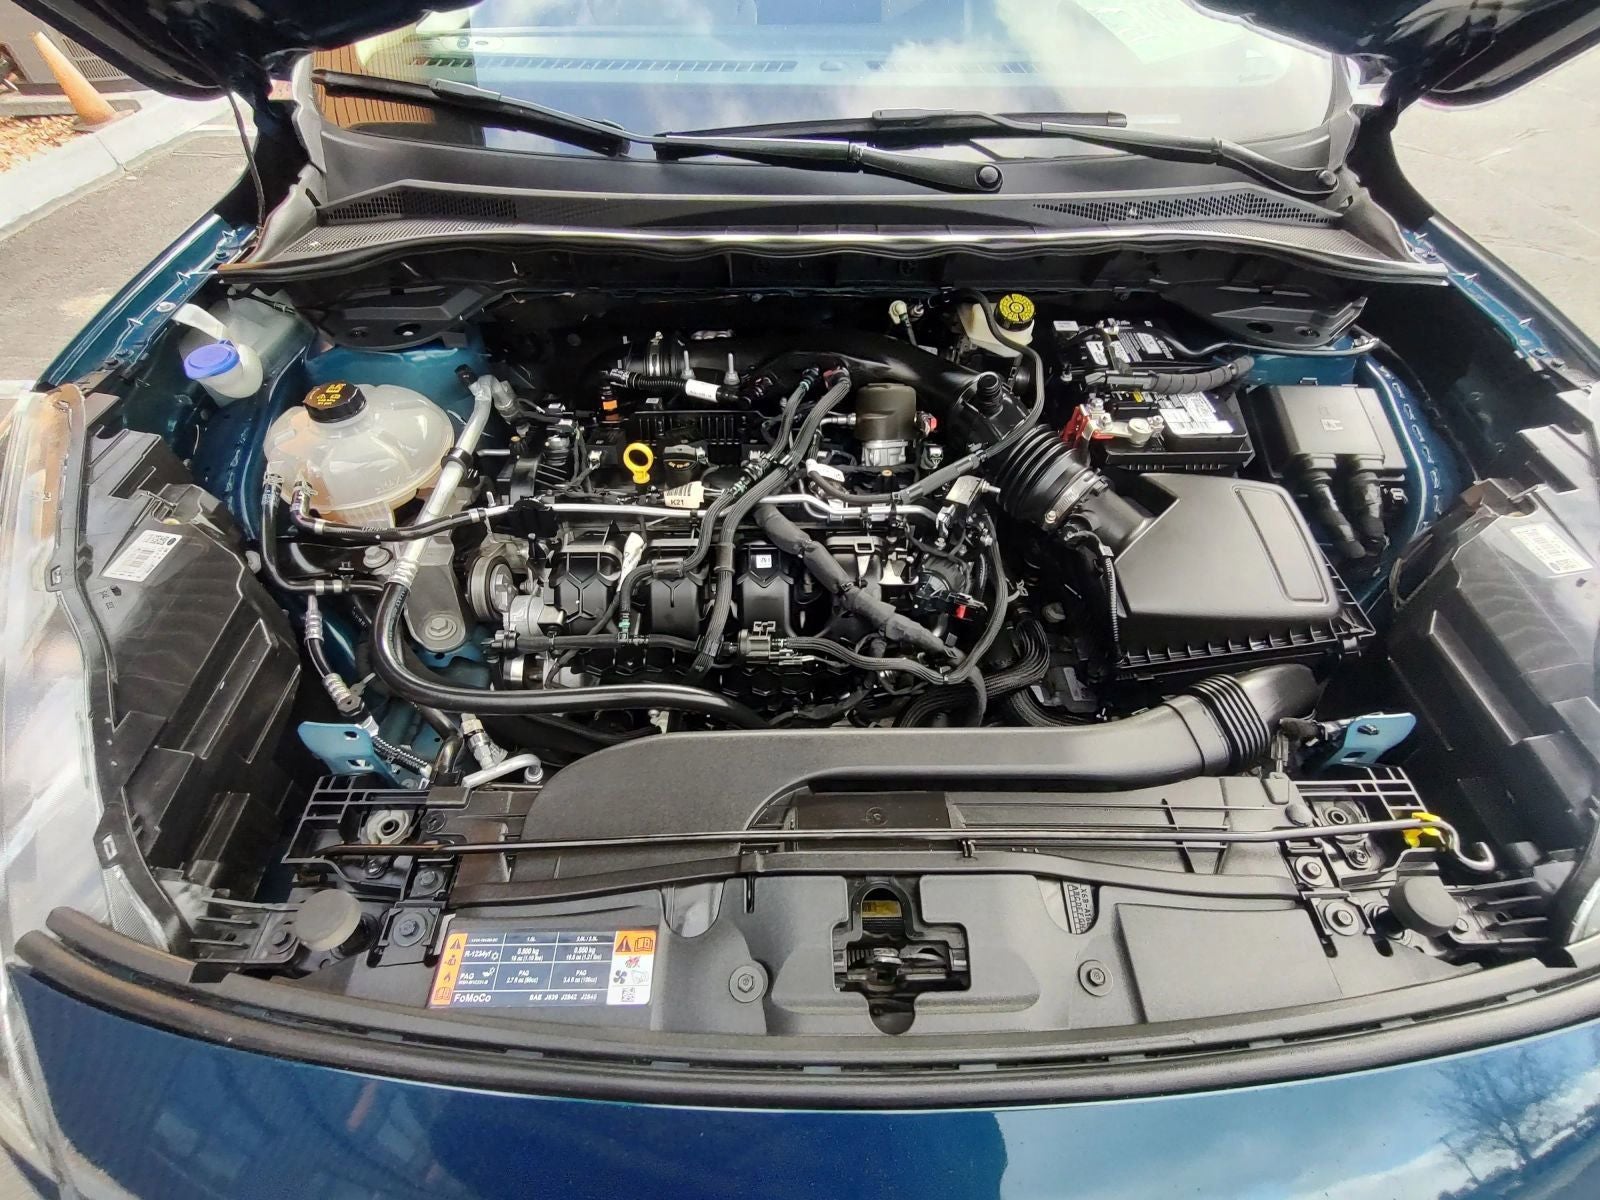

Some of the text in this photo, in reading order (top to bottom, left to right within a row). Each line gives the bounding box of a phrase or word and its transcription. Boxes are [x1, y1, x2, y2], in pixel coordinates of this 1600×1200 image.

[464, 950, 491, 960] R-1234yf
[532, 947, 540, 957] kg
[588, 946, 596, 955] kg
[453, 993, 491, 1002] FoMoCo
